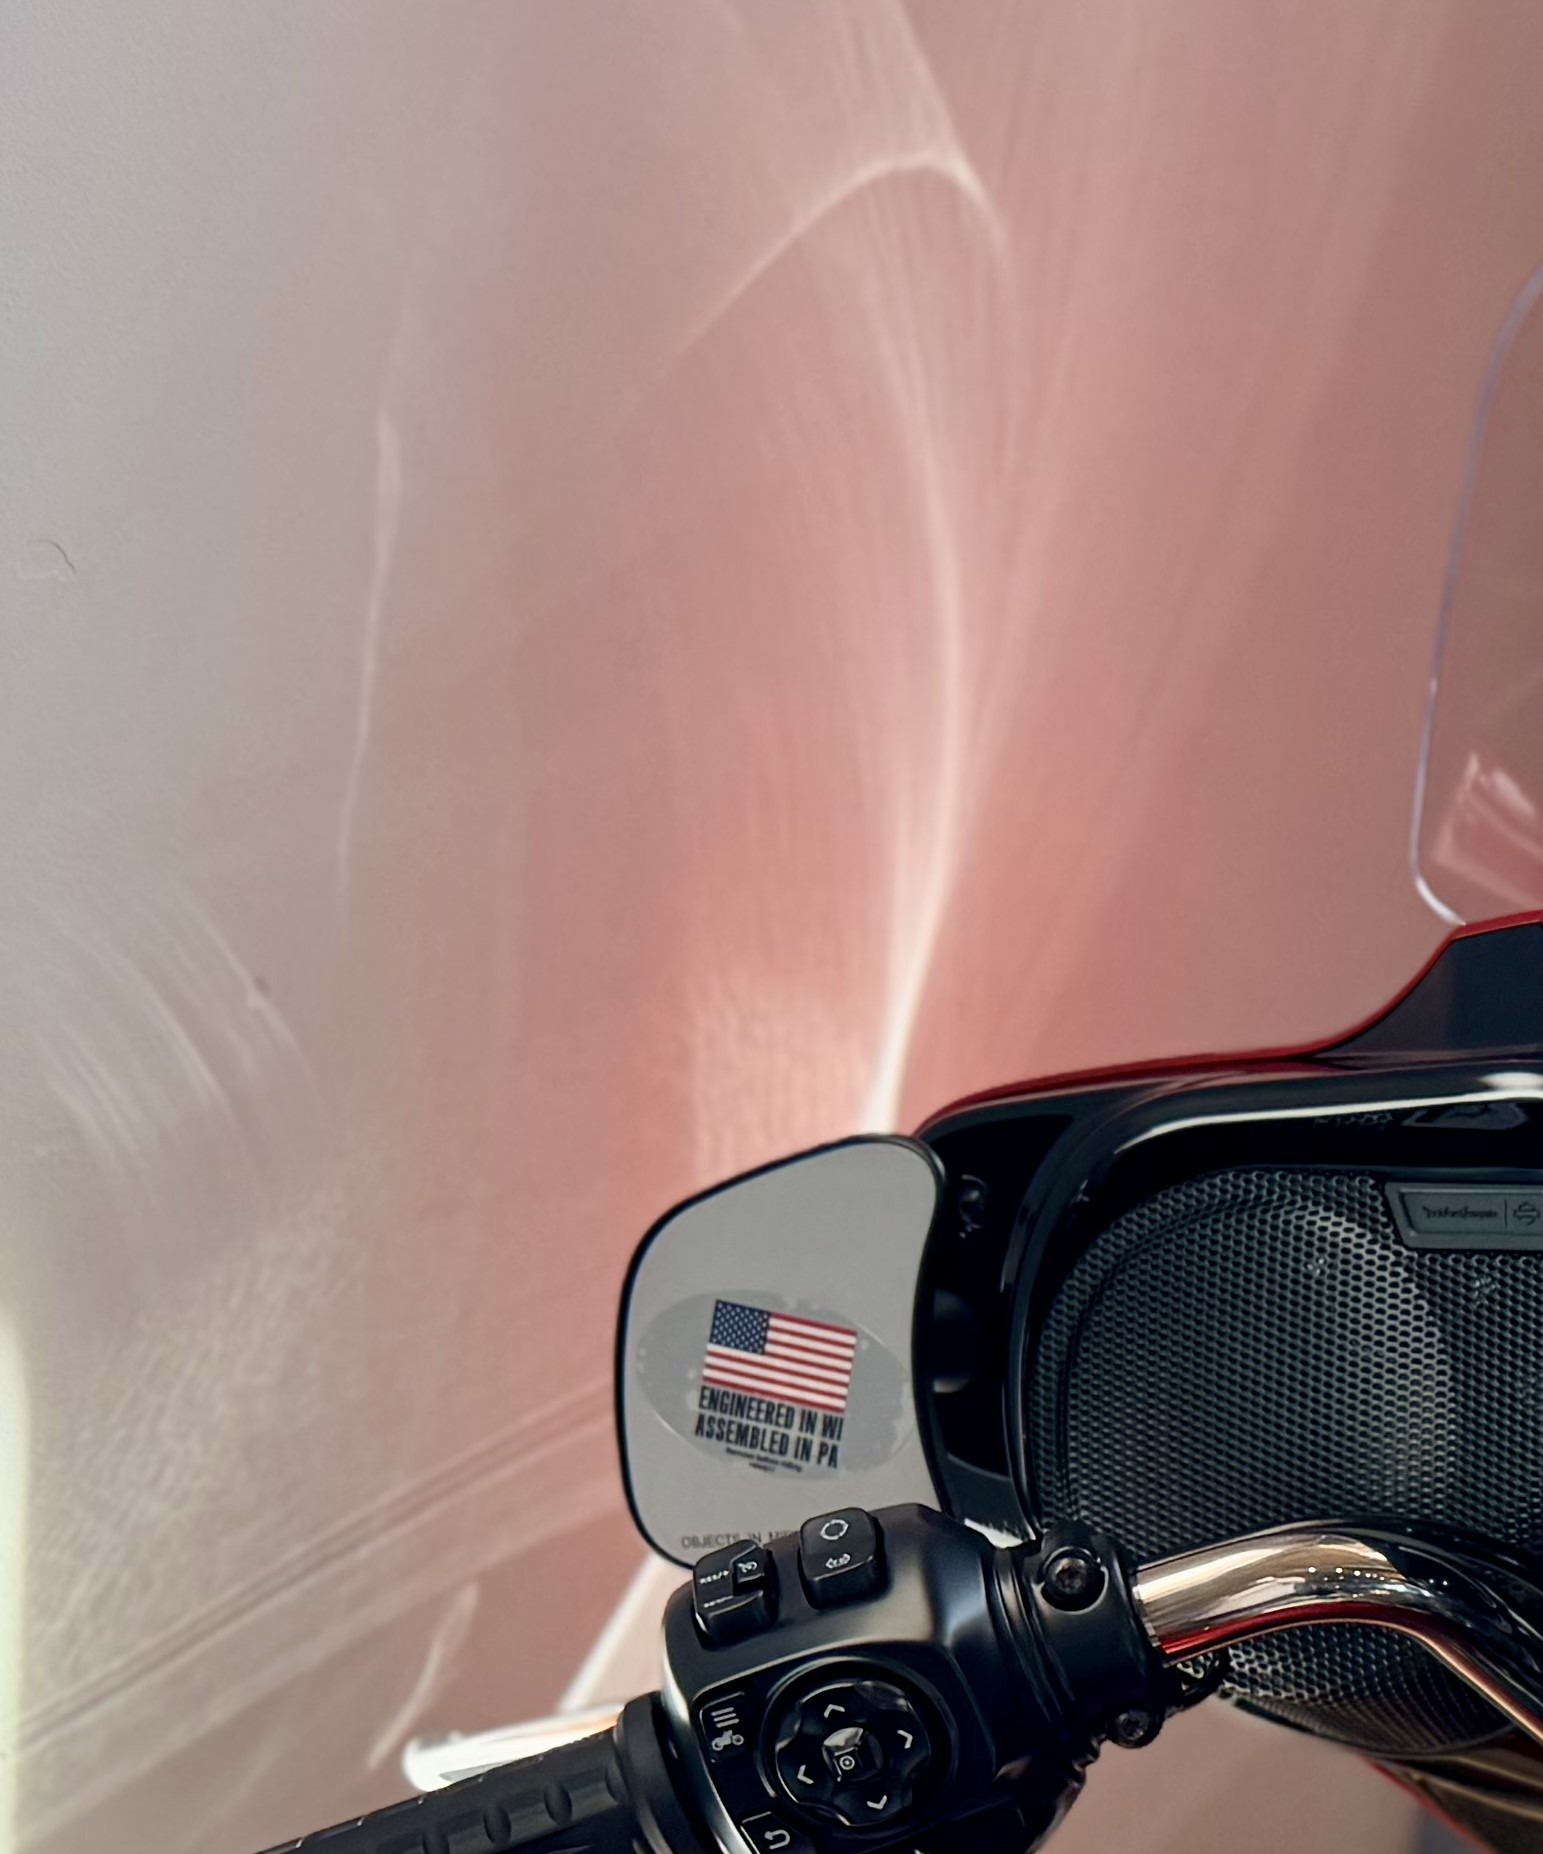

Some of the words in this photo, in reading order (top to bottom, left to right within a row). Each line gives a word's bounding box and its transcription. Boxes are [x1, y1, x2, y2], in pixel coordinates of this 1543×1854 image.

[695, 1413, 790, 1457] ASSEMBLED
[794, 1436, 813, 1463] IN
[817, 1441, 840, 1469] PA
[699, 1386, 795, 1430] ENGINEERED
[799, 1409, 818, 1435] IN
[822, 1413, 844, 1441] WI
[681, 1533, 741, 1549] OBJECT
